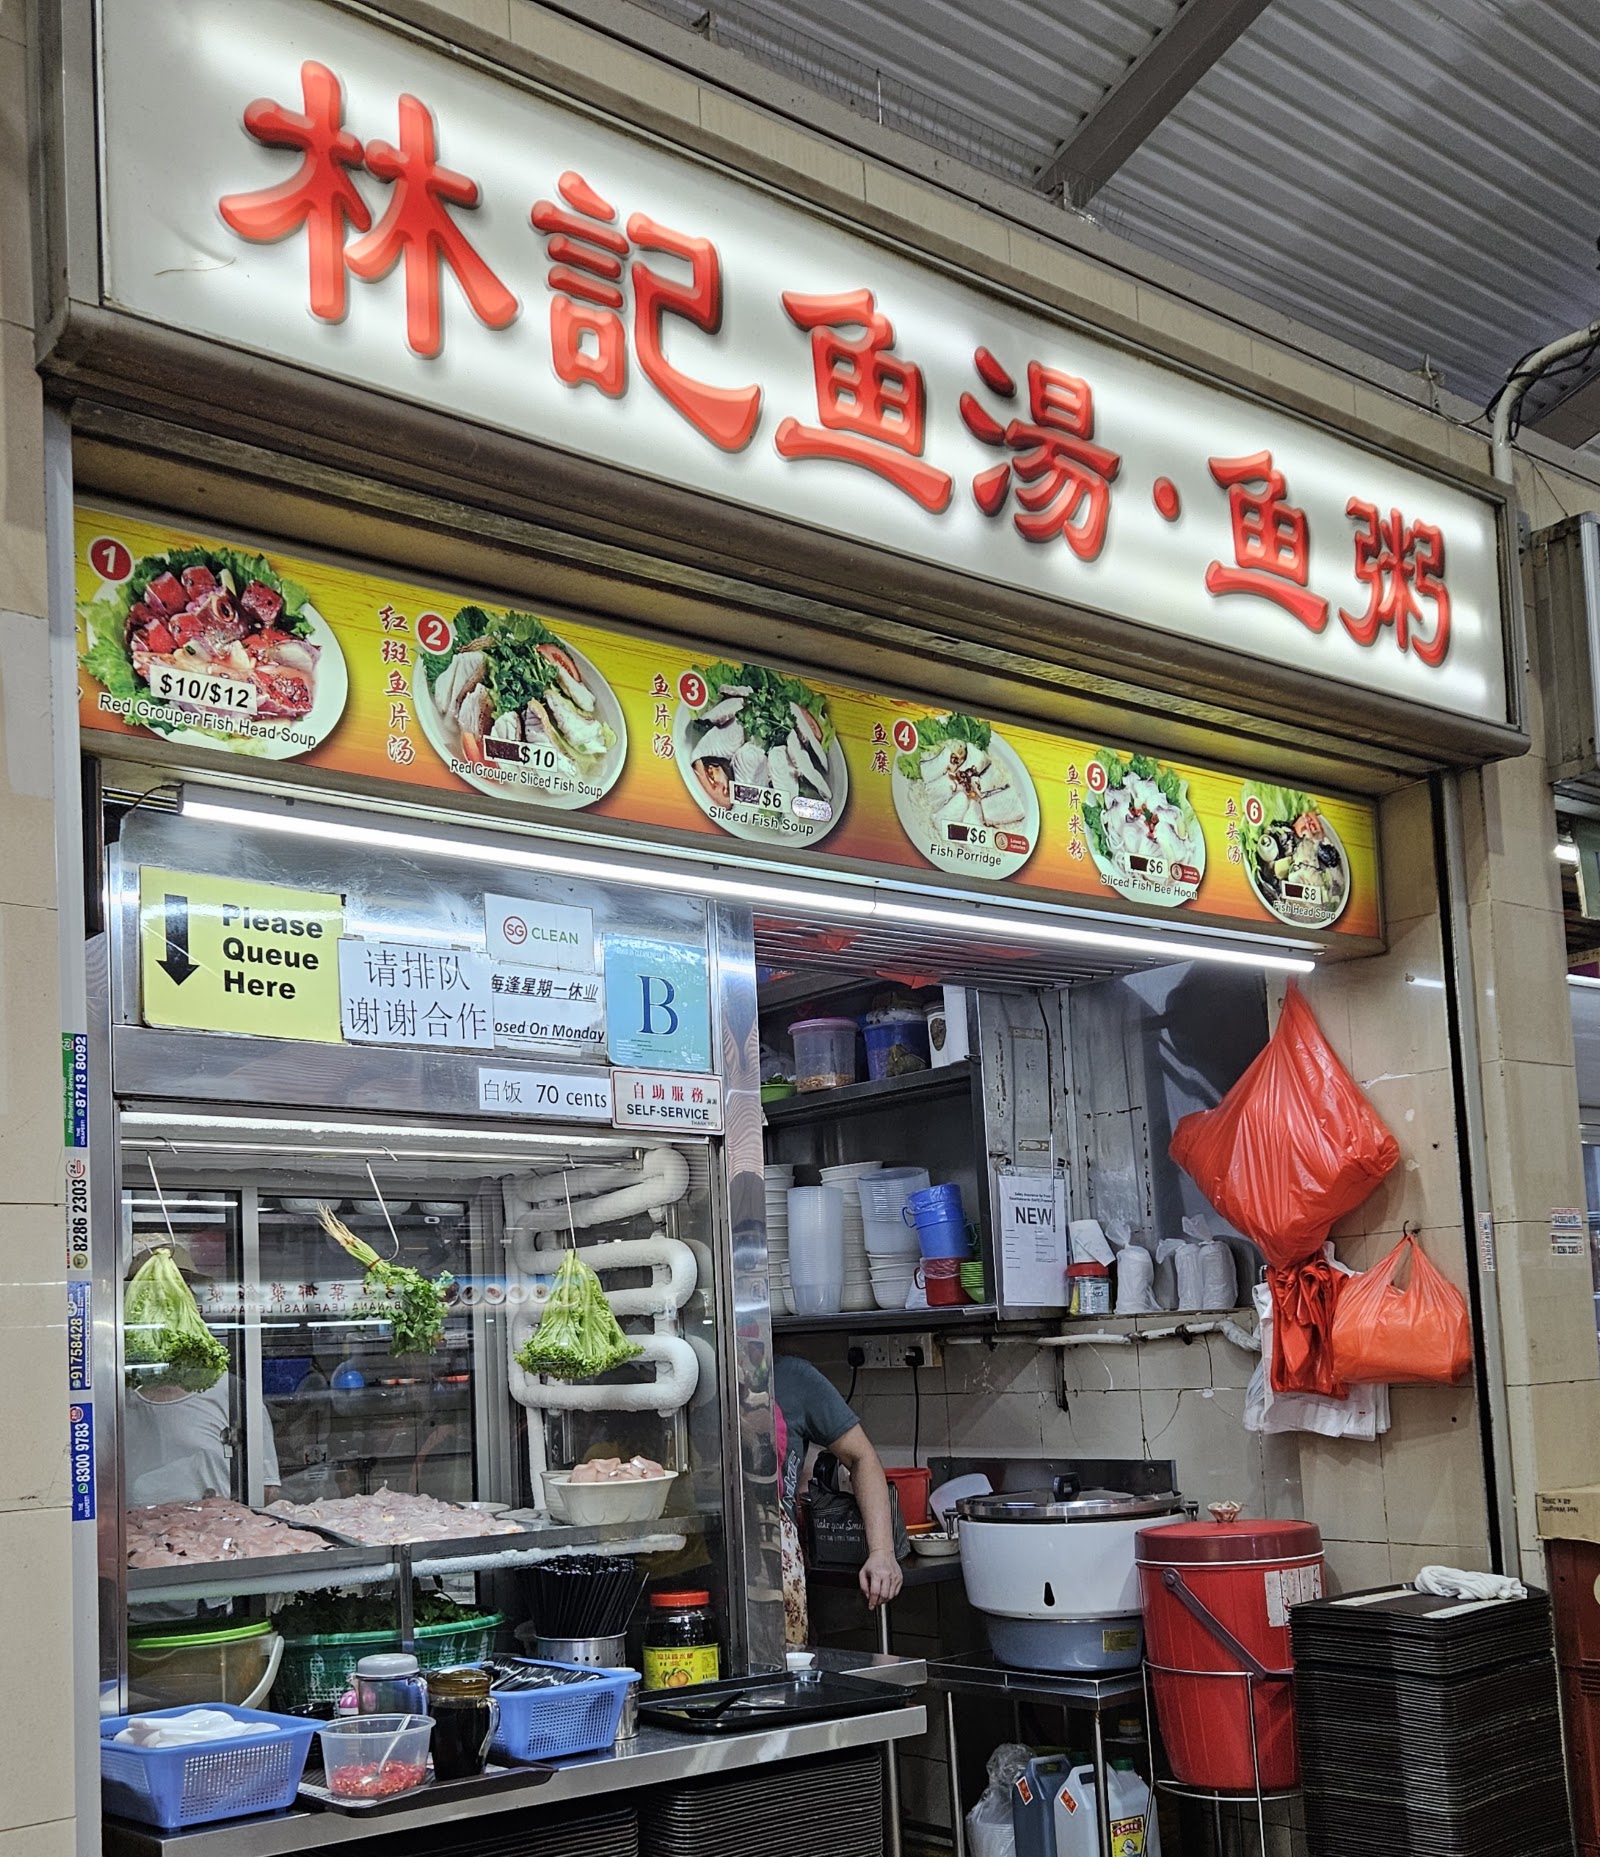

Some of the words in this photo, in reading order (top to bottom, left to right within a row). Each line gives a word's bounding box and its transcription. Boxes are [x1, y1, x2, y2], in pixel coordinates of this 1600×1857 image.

[102, 546, 116, 573] 1
[425, 620, 442, 646] 2
[159, 673, 249, 709] $10/$12
[379, 604, 415, 765] 红斑鱼片汤
[686, 678, 699, 701] 3
[99, 694, 131, 713] Red
[137, 701, 199, 728] Grouper
[203, 713, 234, 731] Fish
[239, 721, 276, 739] Head
[280, 727, 316, 748] Soup
[650, 674, 675, 760] 鱼片汤
[898, 726, 910, 746] 4
[519, 747, 555, 768] $10
[451, 759, 472, 774] Red
[475, 763, 517, 784] Grouper
[520, 772, 551, 789] Sliced
[553, 777, 575, 793] Fish
[577, 781, 603, 798] Soup
[1091, 767, 1101, 787] 5
[709, 806, 748, 823] Sliced
[752, 813, 778, 829] Fish
[783, 819, 814, 836] Soup
[1066, 764, 1087, 861] 鱼片米粉
[1249, 802, 1260, 821] 6
[1225, 798, 1241, 865] 鱼头汤
[930, 844, 954, 858] Fish
[956, 849, 1002, 867] Porridge
[1148, 860, 1163, 874] $6
[1101, 874, 1130, 888] Sliced
[1132, 880, 1152, 892] Fish
[1154, 883, 1171, 895] Bee
[1174, 887, 1197, 899] Hoon
[222, 904, 323, 939] Please
[1273, 901, 1291, 913] Fish
[1293, 904, 1313, 917] Head
[1316, 908, 1336, 921] Soup
[531, 927, 579, 945] CLEAN
[222, 937, 319, 970] Queue
[223, 970, 296, 1000] Here
[363, 949, 471, 991] 请排队
[491, 973, 599, 1001] 每逢星期一休业
[347, 997, 487, 1040] 谢谢合作
[636, 974, 679, 1036] B
[529, 1022, 548, 1036] On
[552, 1024, 605, 1043] Monday
[75, 1036, 86, 1070] 8092
[75, 1074, 87, 1108] 8713
[483, 1079, 523, 1104] 白饭
[536, 1084, 559, 1104] 70
[566, 1091, 607, 1109] cents
[633, 1082, 705, 1103] 自助服務
[627, 1104, 709, 1120] SELF-SERVICE
[72, 1179, 87, 1213] 2303
[1015, 1206, 1052, 1225] NEW
[72, 1218, 87, 1252] 8286
[70, 1318, 83, 1379] 91758428
[75, 1423, 89, 1451] 9783
[75, 1454, 90, 1482] 8300
